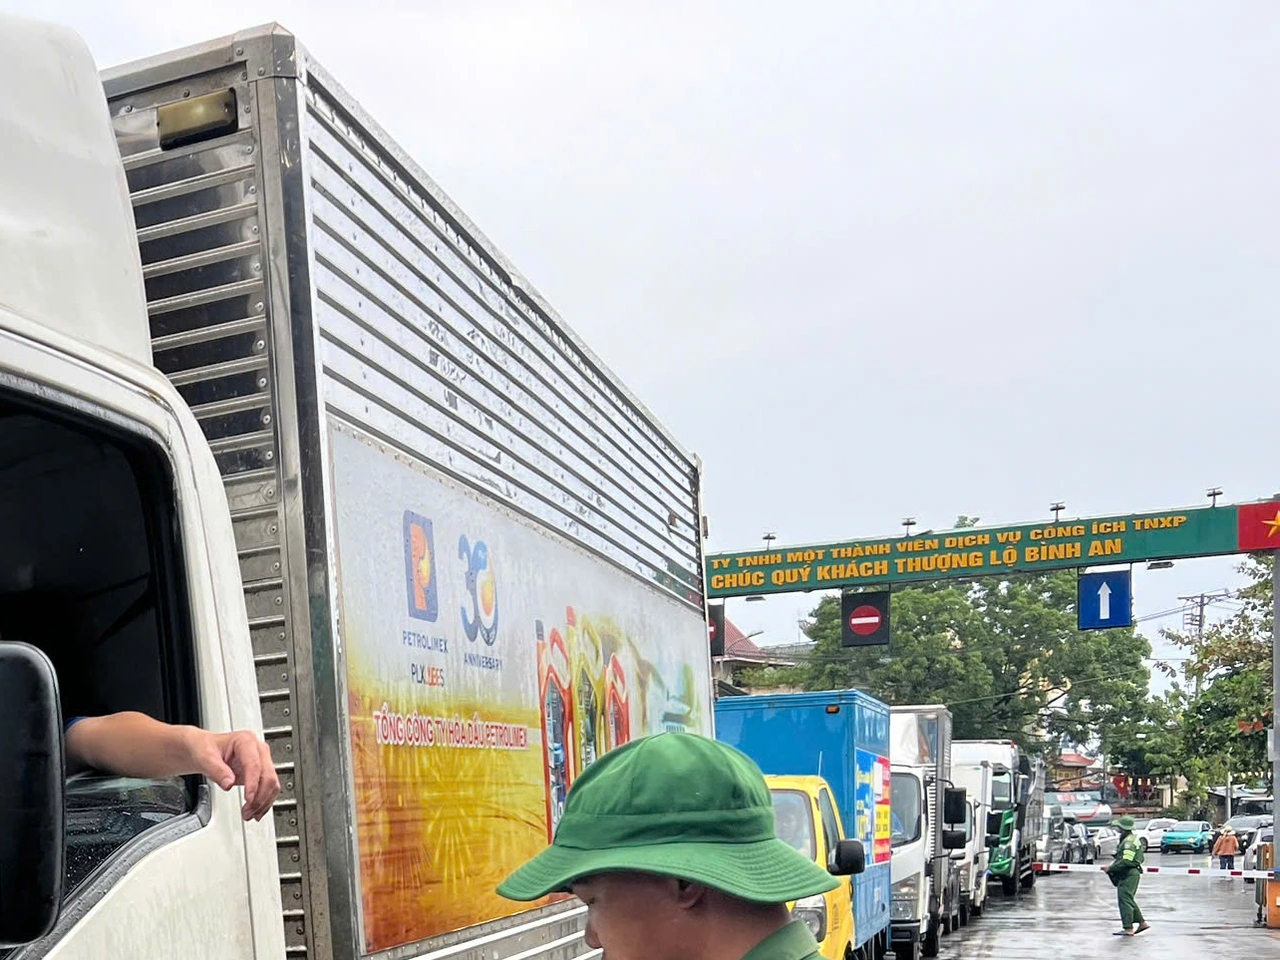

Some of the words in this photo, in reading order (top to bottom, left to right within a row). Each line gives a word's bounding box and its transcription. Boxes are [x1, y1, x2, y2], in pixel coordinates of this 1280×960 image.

[711, 558, 731, 569] TY
[736, 553, 782, 568] TNHH
[787, 549, 825, 565] MỘT
[831, 543, 891, 560] THÀNH
[896, 537, 939, 552] VIÊN
[945, 533, 990, 549] DỊCH
[997, 530, 1022, 544] VỤ
[1030, 523, 1086, 540] CÔNG
[1092, 519, 1126, 535] ÍCH
[1132, 515, 1187, 531] TNXP
[711, 569, 766, 589] CHÚC
[771, 564, 812, 586] QUÝ
[817, 557, 889, 581] KHÁCH
[894, 549, 984, 575] THƯỢNG
[990, 545, 1019, 568] LỘ
[1025, 541, 1082, 563] BÌNH
[1088, 538, 1122, 557] AN
[402, 630, 449, 653] PETROLIMEX
[464, 653, 503, 671] ANNIVERSARY
[373, 702, 404, 745] TỔNG
[405, 710, 434, 746] CÔNG
[435, 717, 447, 746] TY
[484, 721, 529, 749] PETROLIMEX
